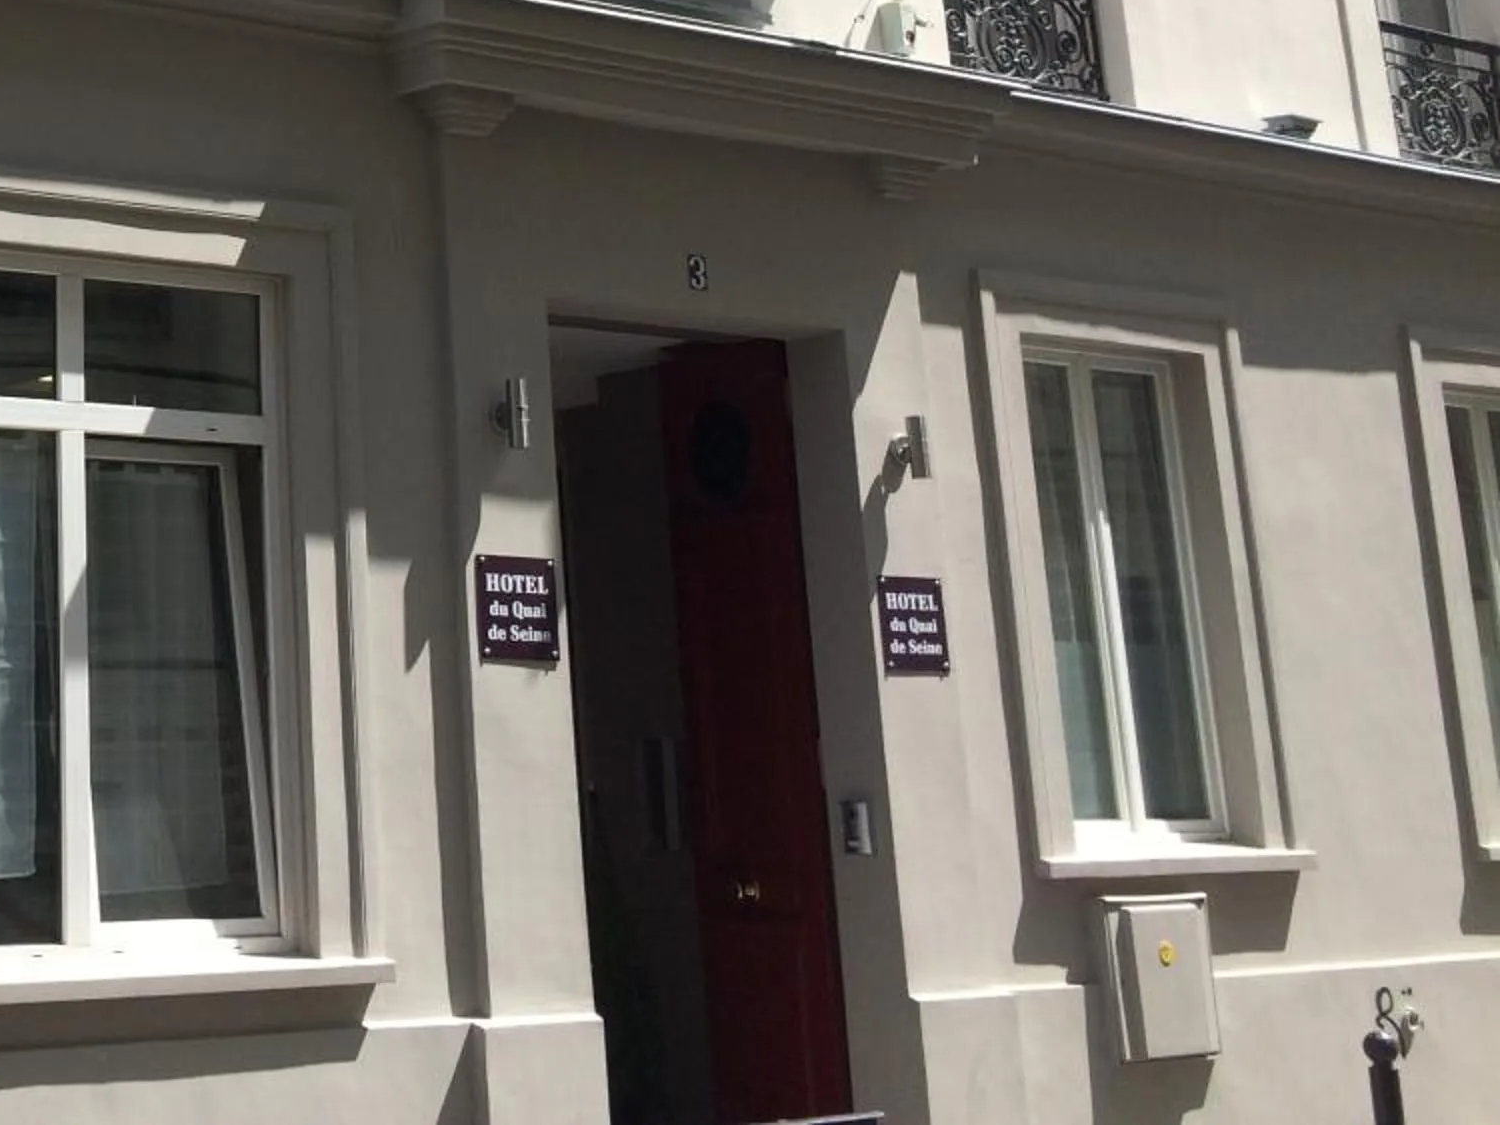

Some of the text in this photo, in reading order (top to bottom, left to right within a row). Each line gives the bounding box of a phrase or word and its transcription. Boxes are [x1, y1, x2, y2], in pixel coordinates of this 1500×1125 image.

[688, 255, 707, 290] 3
[485, 572, 549, 594] HOTEL
[489, 600, 548, 620] du Quai
[885, 592, 939, 611] HOTEL
[487, 624, 507, 641] de
[890, 616, 938, 636] du Quai
[890, 638, 906, 654] de
